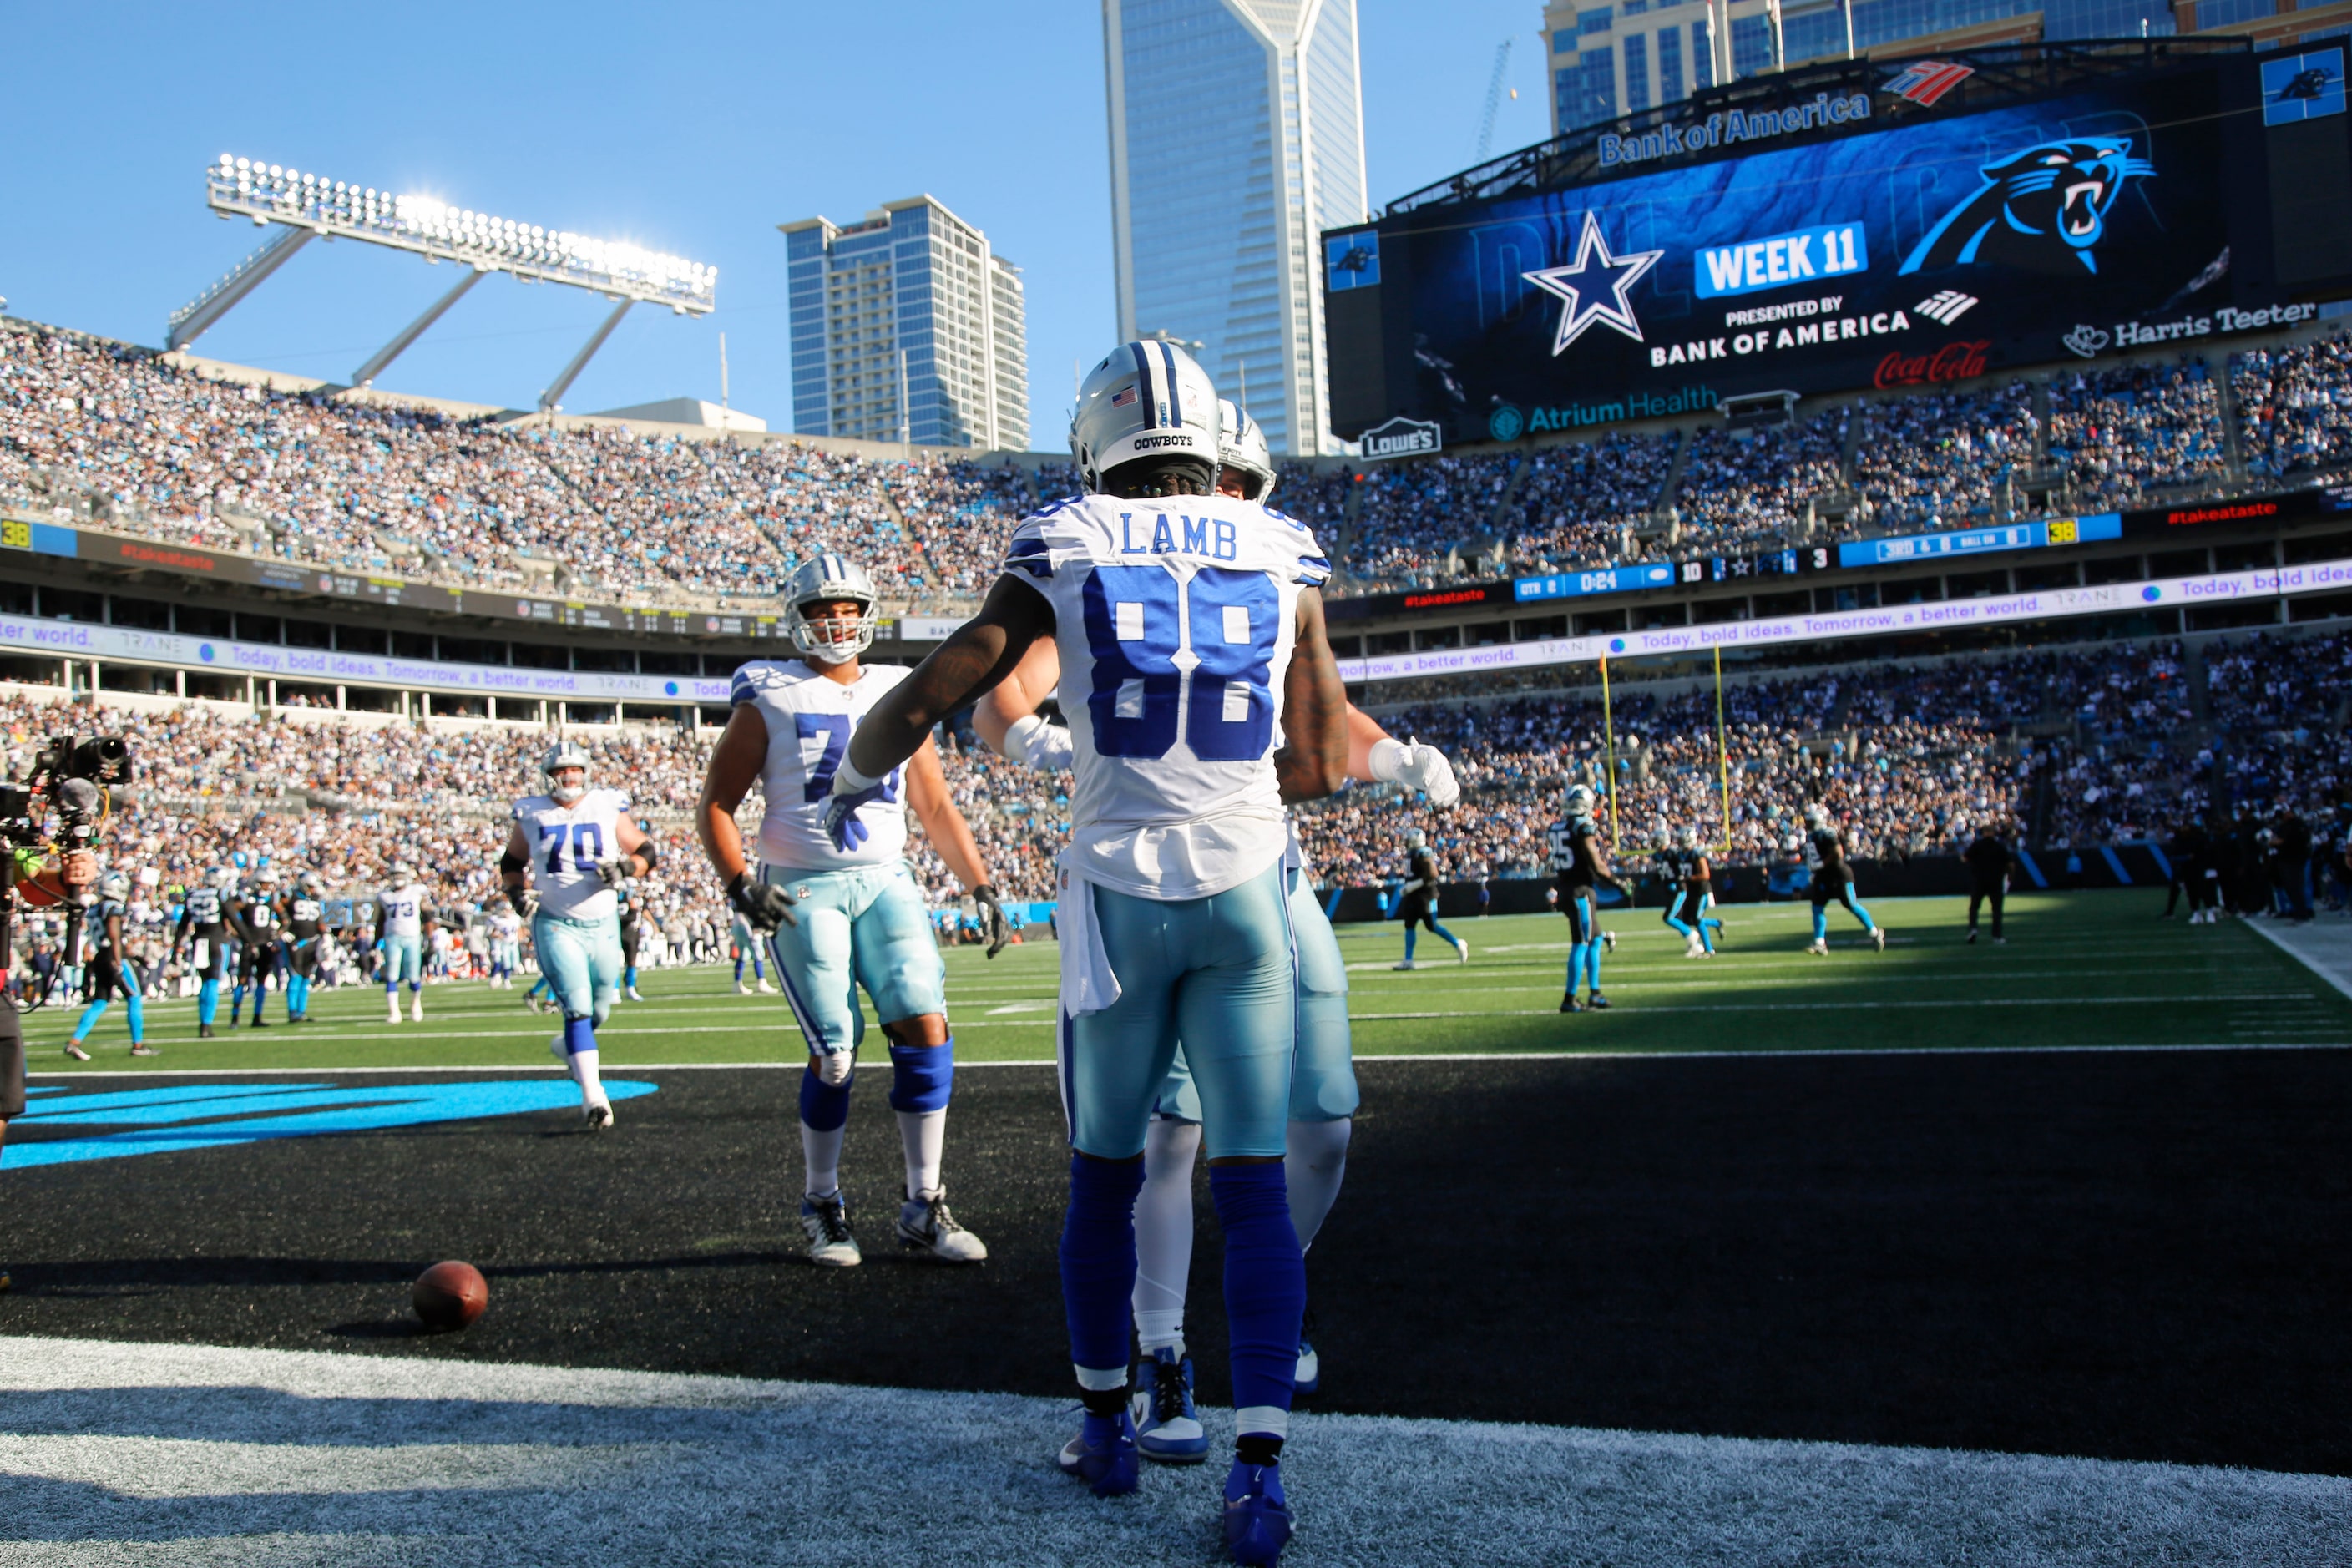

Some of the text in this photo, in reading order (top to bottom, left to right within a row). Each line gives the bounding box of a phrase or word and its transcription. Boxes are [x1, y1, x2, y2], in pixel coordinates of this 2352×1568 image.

[1597, 92, 1871, 167] Bank of America
[1705, 228, 1858, 291] WEEK 11
[1726, 295, 1843, 327] PRESENTED BY
[2114, 302, 2317, 347] Harris Teeter
[1651, 311, 1910, 367] BANK OF AMERICA
[1528, 384, 1718, 433] Atrium Health
[1134, 435, 1193, 450] COWBOYS
[1367, 429, 1434, 457] LOWE'S
[2167, 503, 2278, 525] #takeataste
[2, 520, 30, 548] 38
[1120, 513, 1237, 561] LAMB
[2049, 520, 2076, 543] 38
[1682, 562, 1702, 582] 10
[1813, 548, 1828, 568] 3
[1581, 571, 1618, 593] 0:24
[2183, 579, 2247, 598] Today,
[2254, 568, 2303, 590] bold
[1404, 589, 1485, 609] #takeataste
[32, 626, 94, 647] world.
[1641, 596, 2043, 650] Today, bold ideas. Tomorrow, a better world.
[232, 645, 284, 671] Today,
[288, 651, 326, 671] bold
[485, 671, 529, 686] better
[536, 675, 579, 691] world.
[1083, 565, 1281, 761] 88
[1404, 660, 1413, 671] a
[1419, 654, 1464, 670] better
[1471, 648, 1518, 665] world.
[693, 682, 731, 696] Toda
[539, 822, 603, 873] 70
[254, 905, 271, 928] 0
[294, 899, 320, 922] 95
[387, 902, 413, 918] 73
